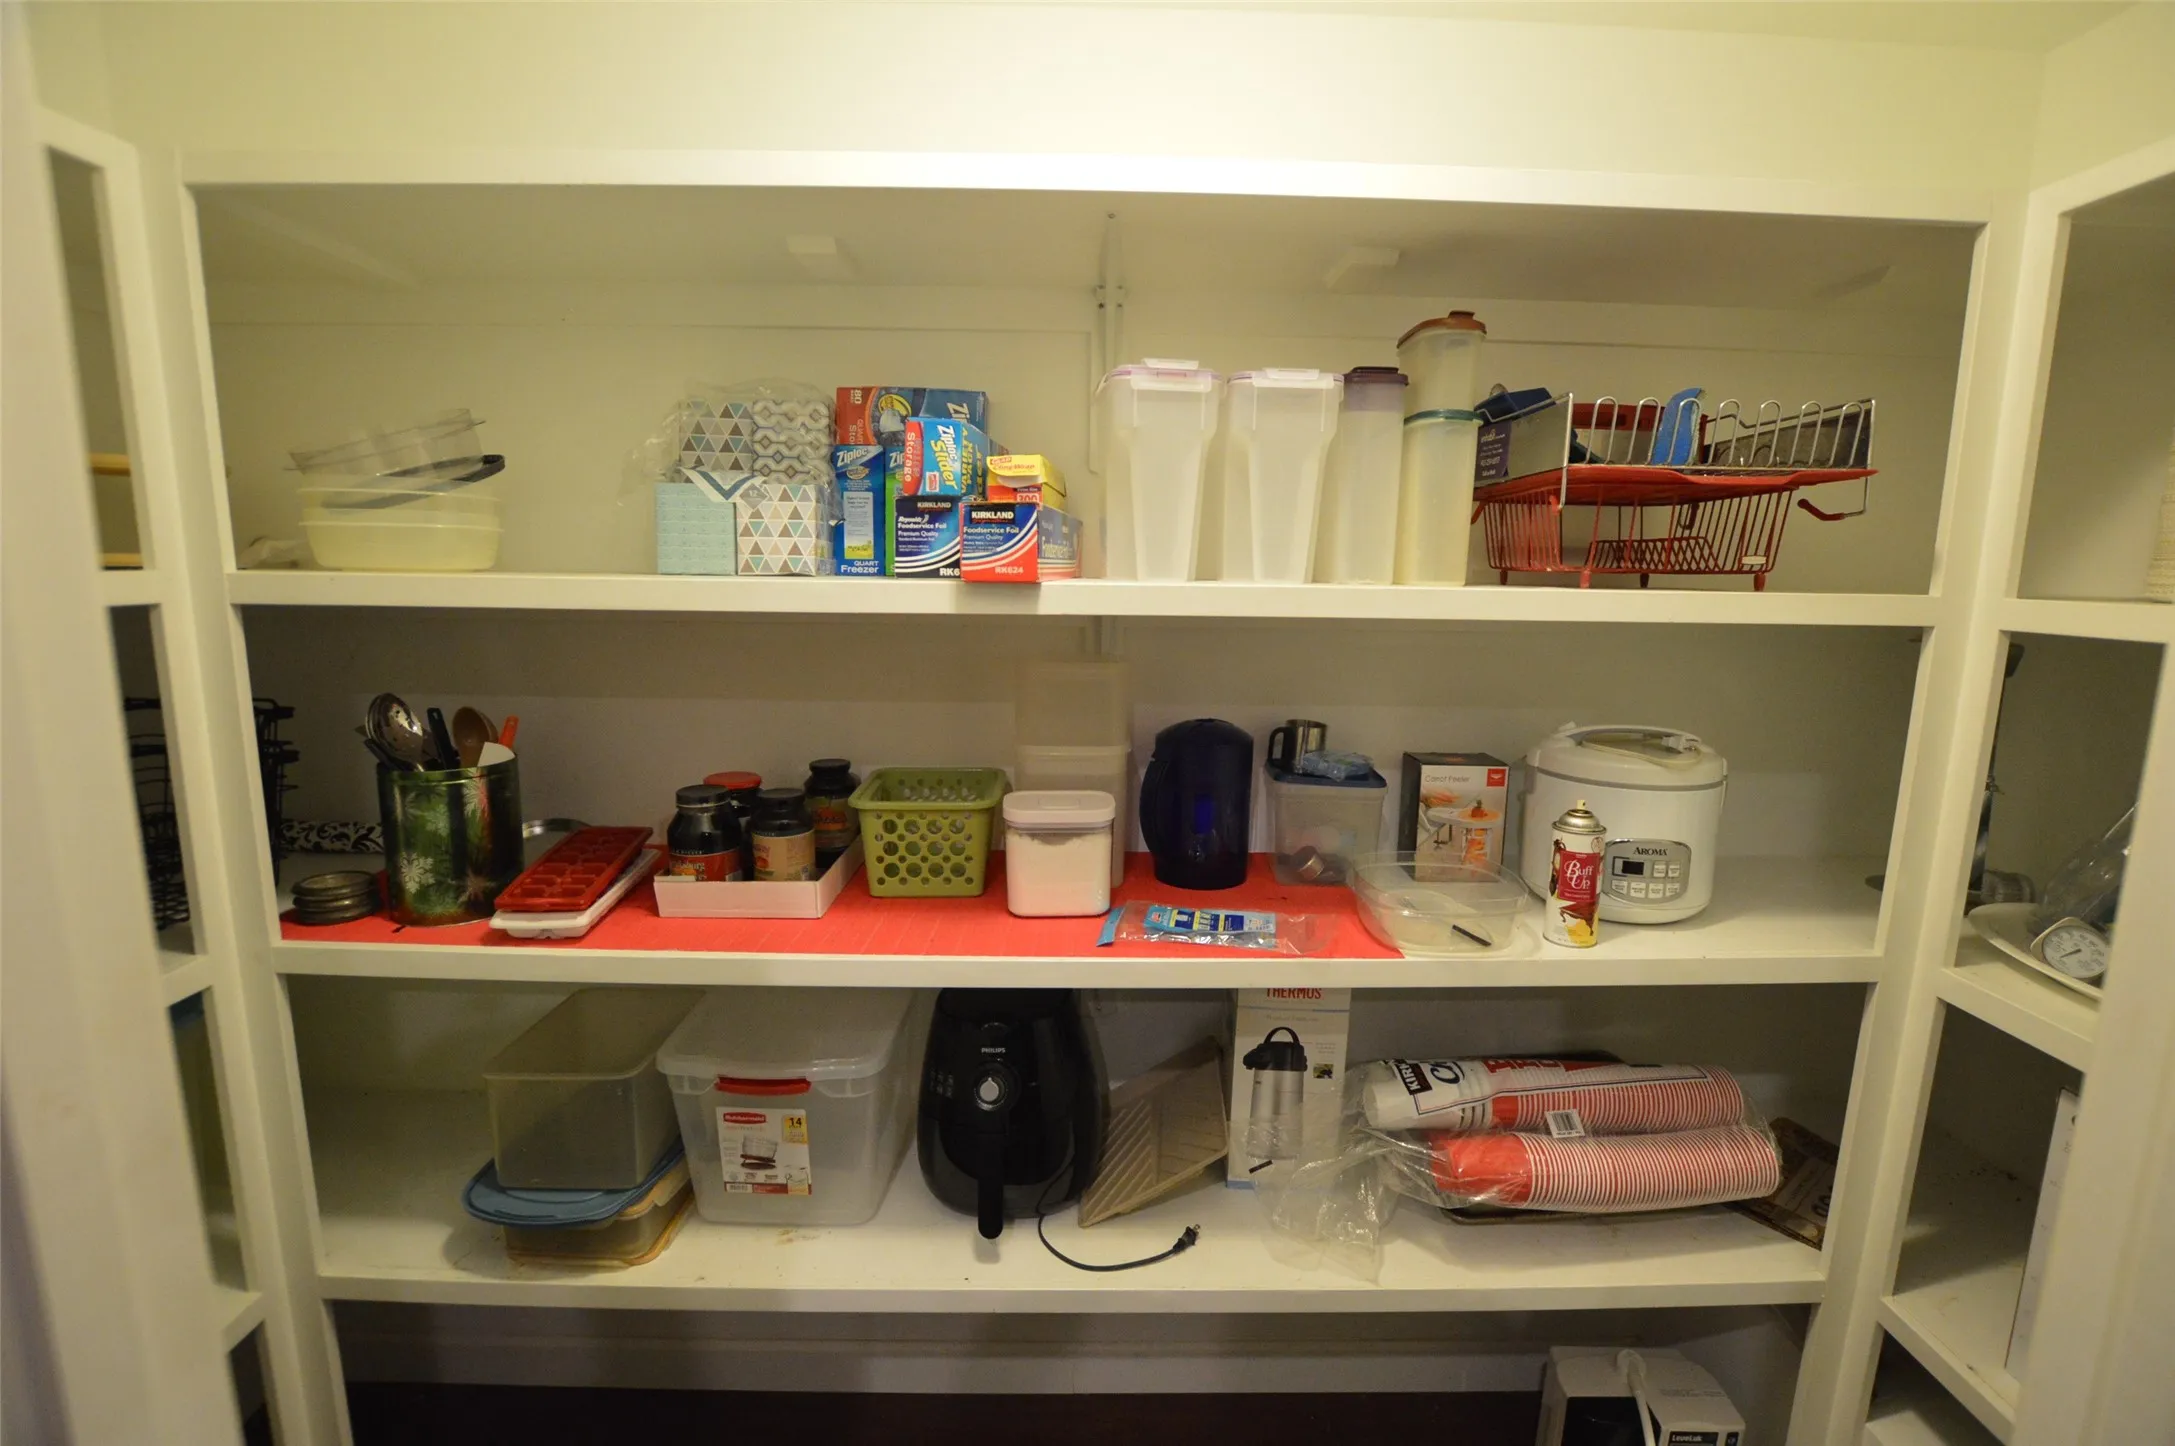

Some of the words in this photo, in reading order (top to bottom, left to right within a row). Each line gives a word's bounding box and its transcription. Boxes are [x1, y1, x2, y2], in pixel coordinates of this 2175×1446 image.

[854, 389, 862, 404] 80
[937, 425, 957, 460] Ziploc
[837, 448, 868, 467] Ziploc
[904, 432, 916, 482] Storage
[930, 440, 958, 490] Slider
[971, 511, 1014, 519] KIRKLAND
[841, 565, 879, 574] Freezer
[1633, 846, 1668, 856] AROMA
[1563, 860, 1595, 877] Buff
[1399, 1063, 1421, 1091] KIRK
[789, 1117, 802, 1126] 14
